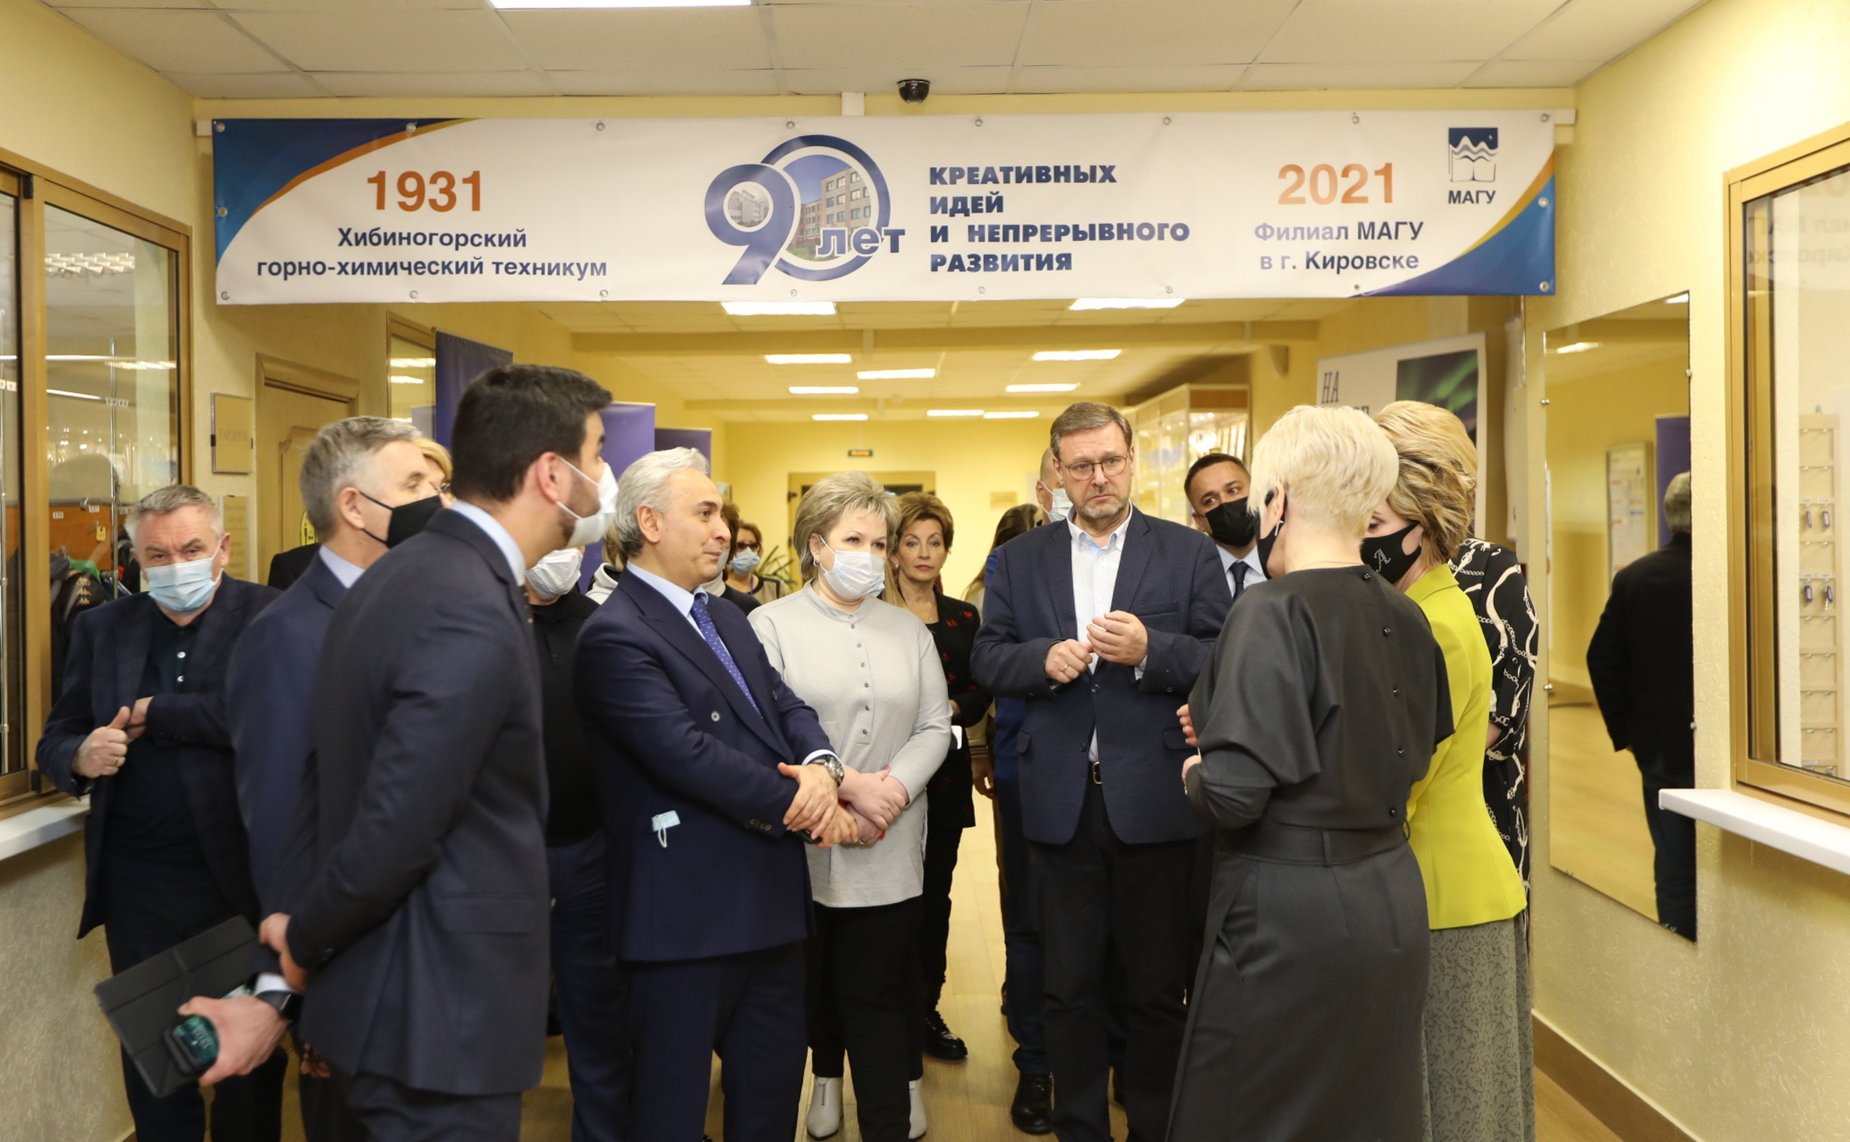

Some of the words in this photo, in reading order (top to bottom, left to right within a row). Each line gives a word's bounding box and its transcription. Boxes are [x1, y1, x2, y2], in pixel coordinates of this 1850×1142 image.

[929, 164, 1117, 186] КРЕАТИВНЫХ
[1279, 161, 1393, 205] 2021
[367, 170, 481, 213] 1931
[929, 190, 1005, 218] ИДЕЙ
[1447, 189, 1496, 205] МАГУ
[336, 226, 527, 251] Хибиногорский
[815, 227, 906, 257] лет
[929, 224, 949, 244] И
[967, 222, 1190, 244] НЕПРЕРЫВНОГО
[1255, 221, 1348, 241] Филиал
[1357, 221, 1425, 240] МАГУ
[257, 254, 484, 281] горно-химический
[491, 260, 607, 281] техникум
[930, 252, 1073, 273] РАЗВИТИЯ
[1260, 256, 1273, 270] в
[1281, 255, 1297, 271] г.
[1306, 251, 1418, 274] Кировске
[1322, 371, 1340, 403] НА
